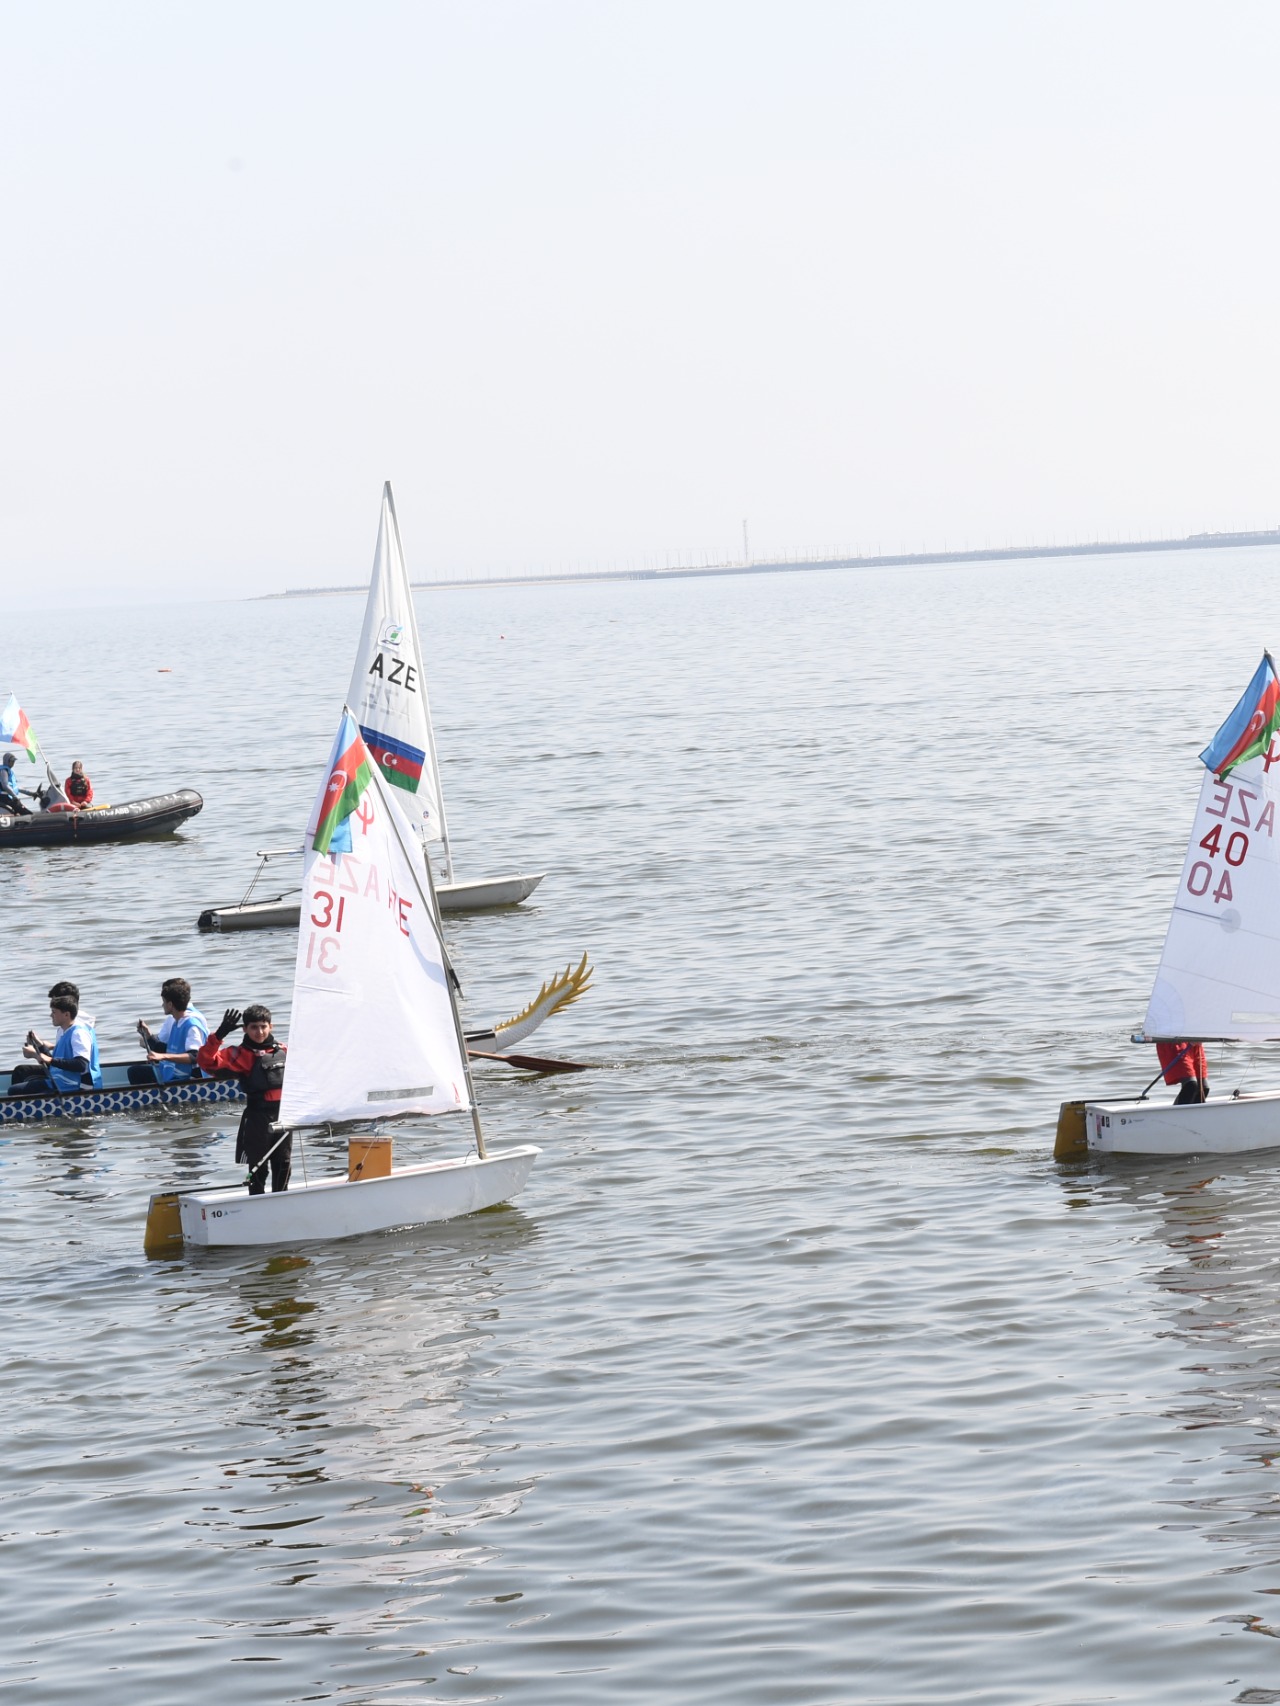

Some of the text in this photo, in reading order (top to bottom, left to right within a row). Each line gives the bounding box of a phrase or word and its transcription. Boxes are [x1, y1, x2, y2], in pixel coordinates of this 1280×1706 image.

[368, 652, 417, 693] AZE
[1199, 823, 1249, 867] 40
[310, 890, 345, 932] 31
[211, 1210, 223, 1219] 10
